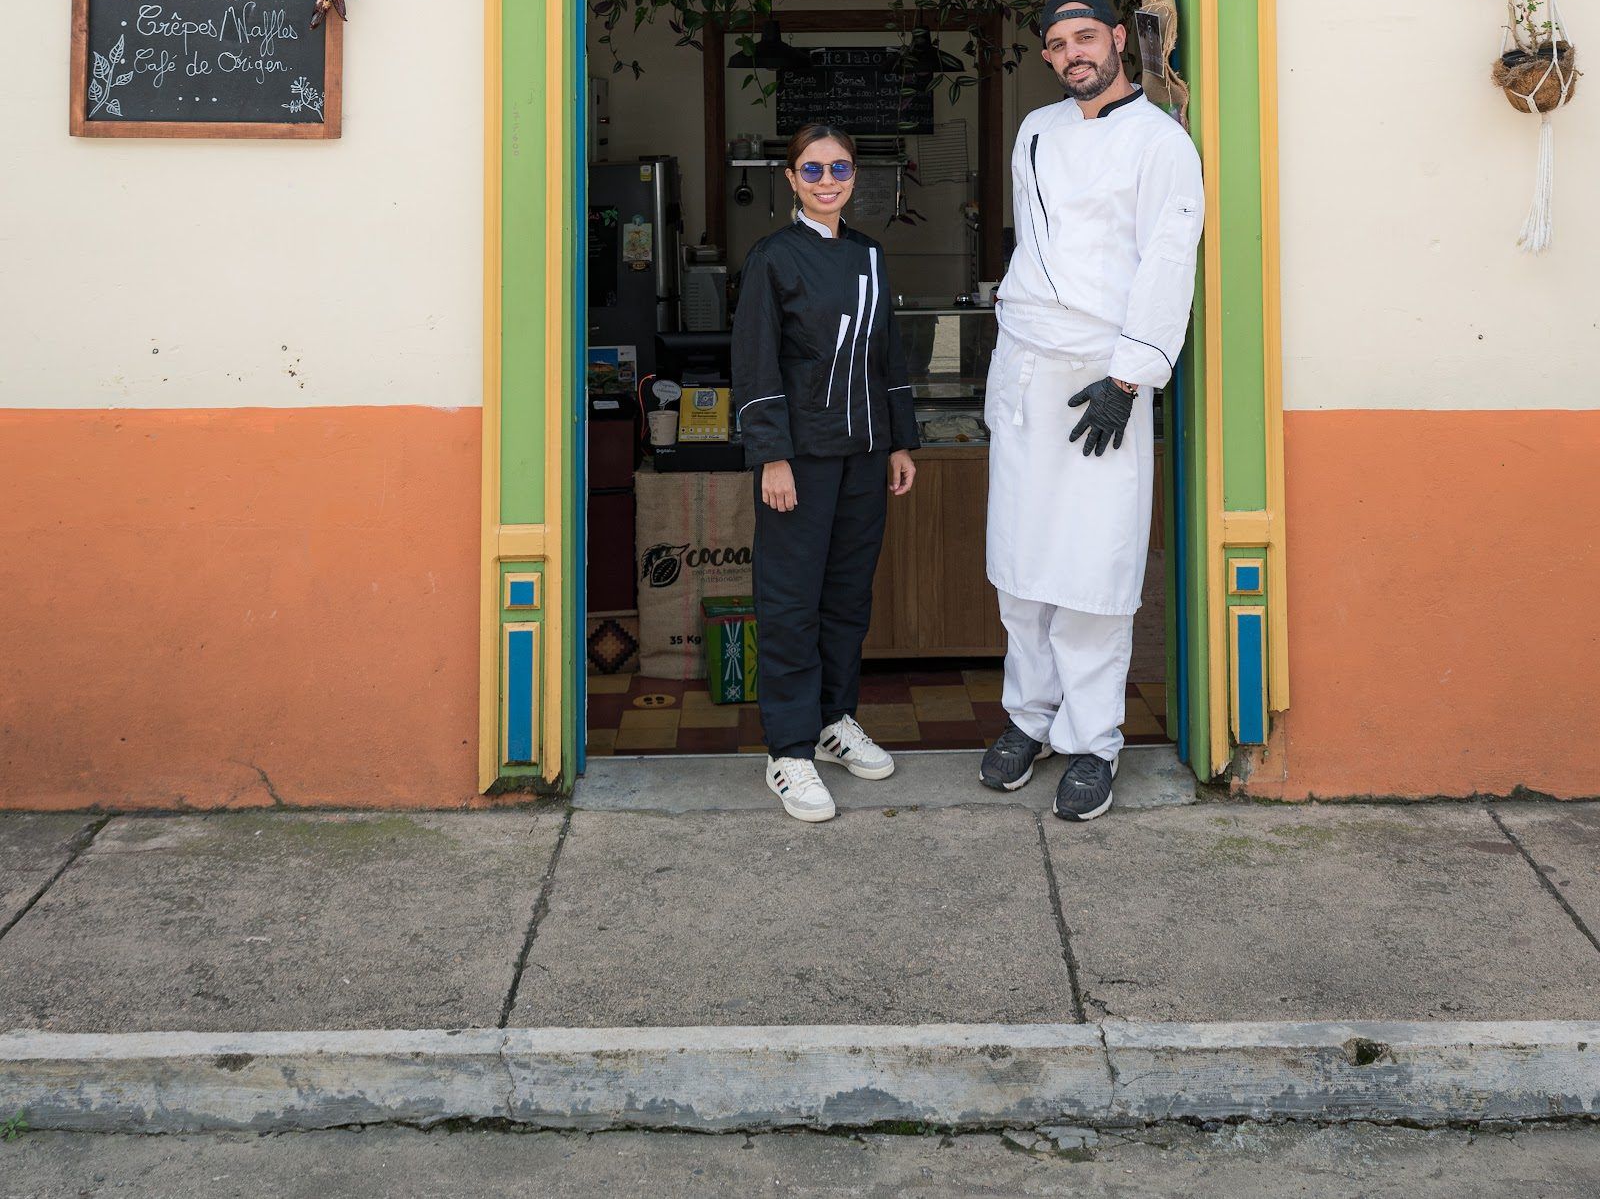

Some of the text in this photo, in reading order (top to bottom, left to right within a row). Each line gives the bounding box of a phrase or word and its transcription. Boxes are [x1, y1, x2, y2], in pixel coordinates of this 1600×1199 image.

[133, 48, 177, 88] Café
[185, 51, 213, 77] de
[669, 635, 702, 646] 35 Kg
